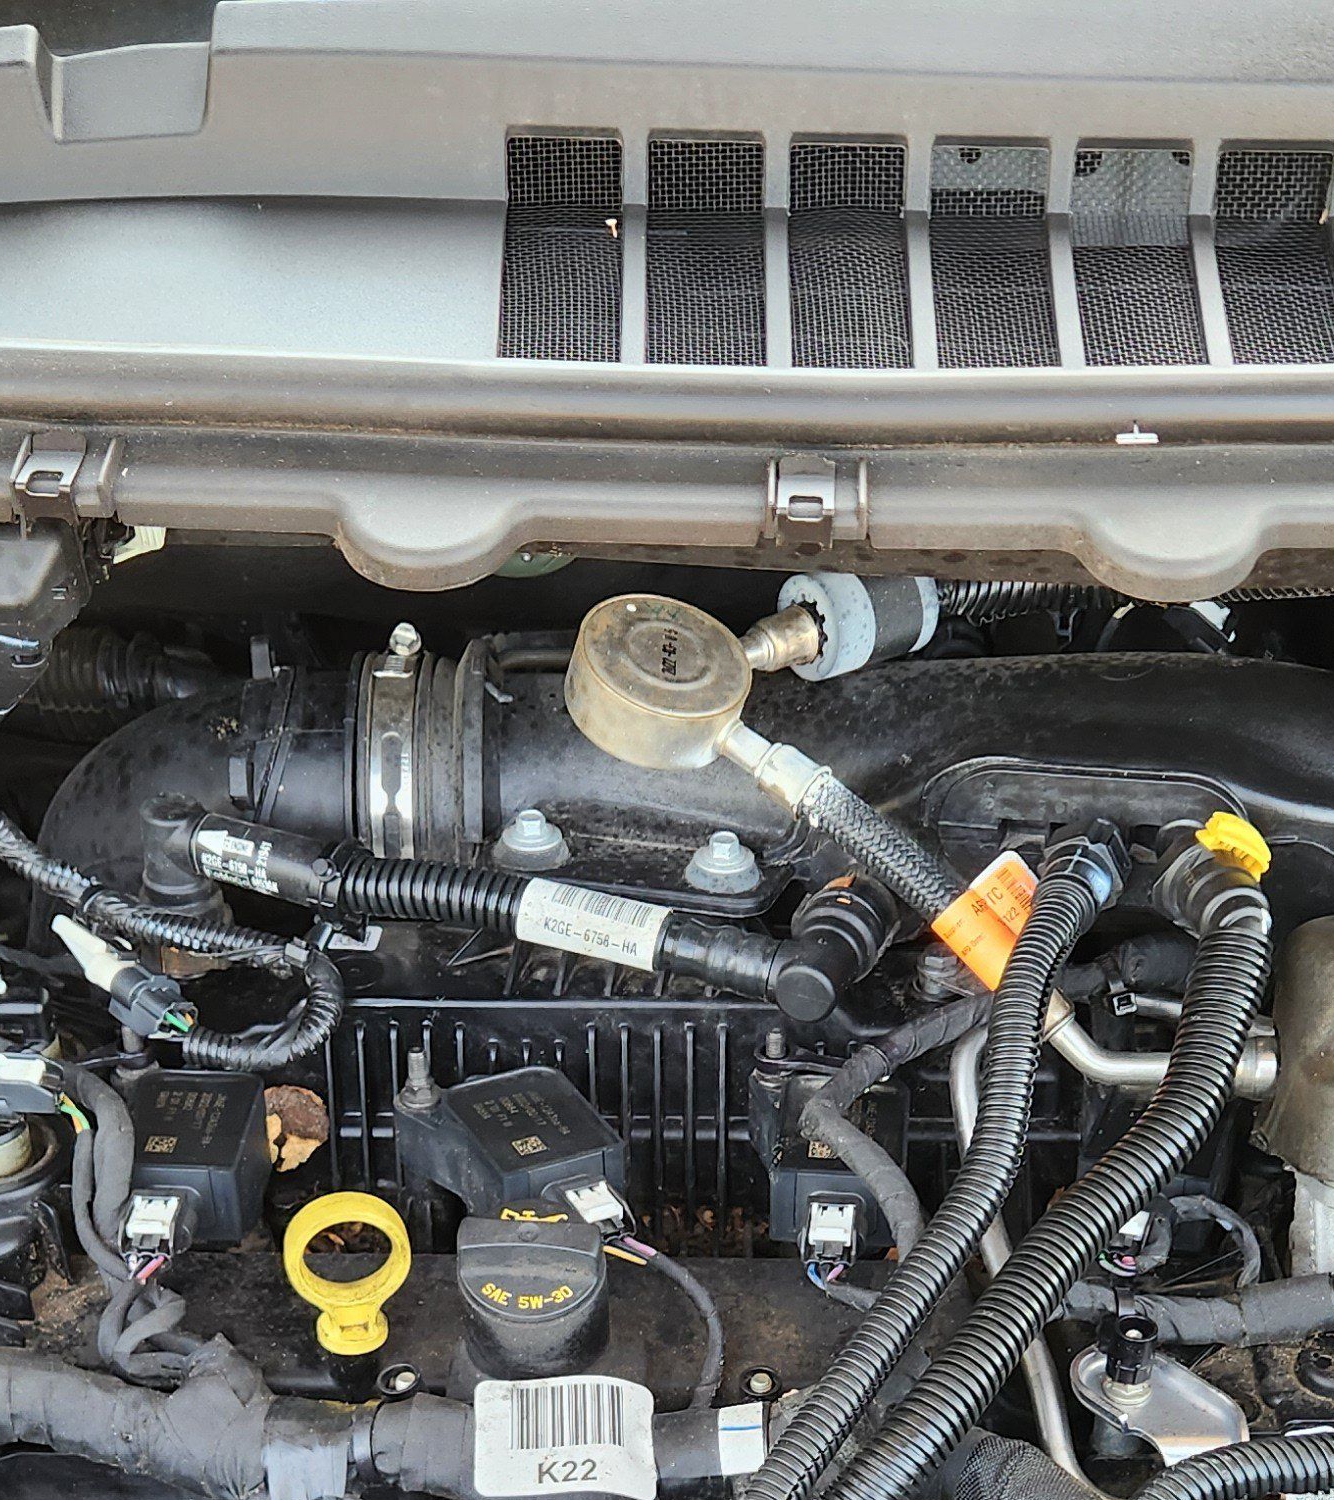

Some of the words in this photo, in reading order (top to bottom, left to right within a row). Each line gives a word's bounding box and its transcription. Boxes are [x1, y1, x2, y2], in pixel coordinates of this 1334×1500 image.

[542, 915, 639, 957] K2GE-6758-HA
[481, 1282, 513, 1306] SAE
[518, 1285, 574, 1310] 5W-30
[537, 1458, 598, 1485] K22
